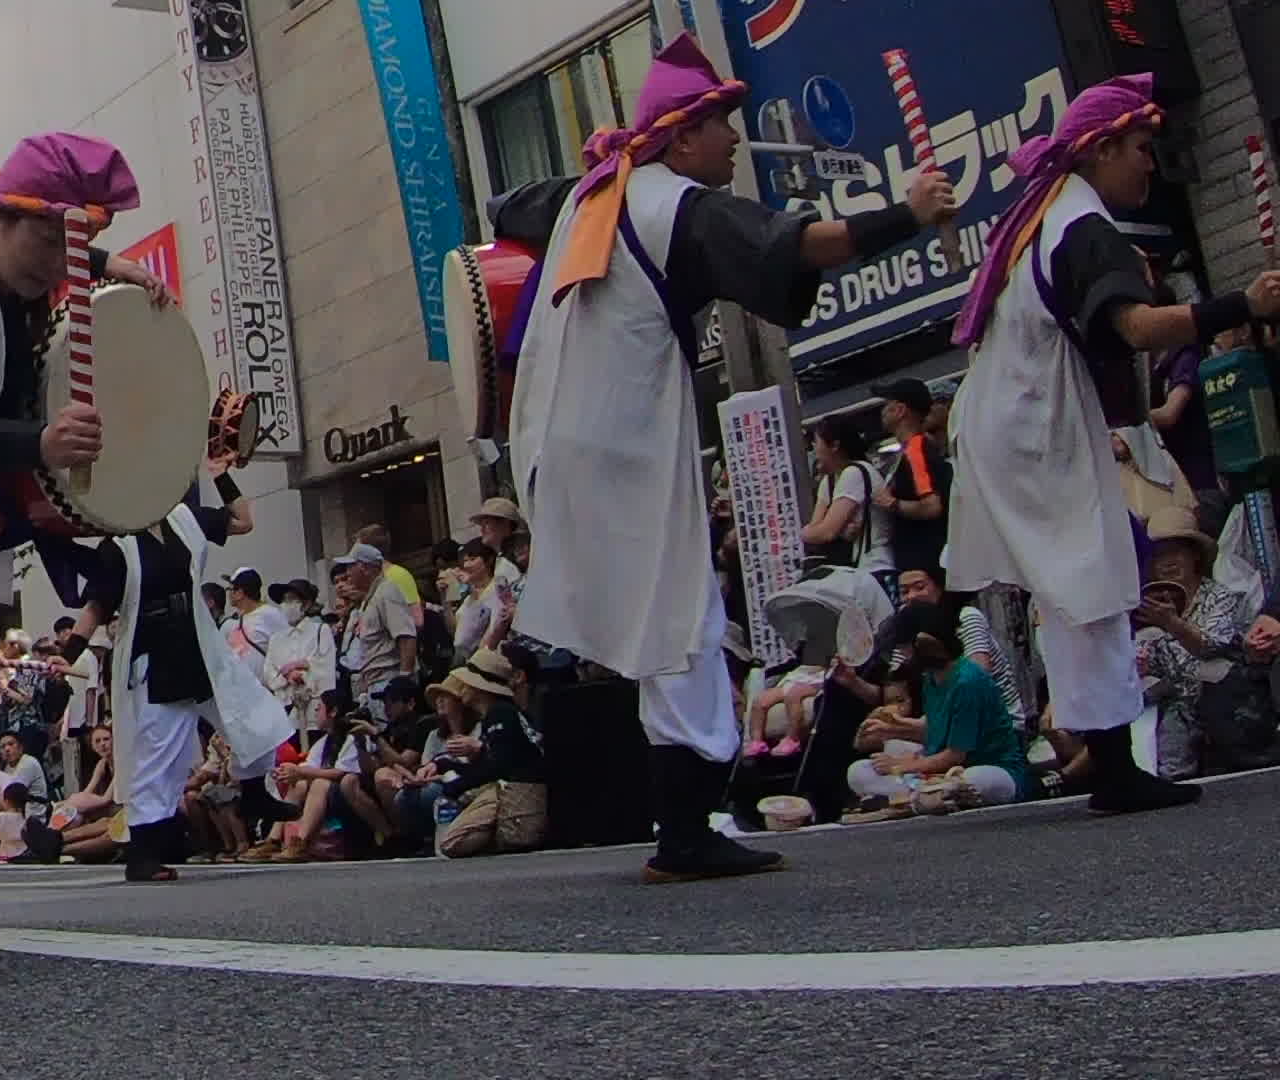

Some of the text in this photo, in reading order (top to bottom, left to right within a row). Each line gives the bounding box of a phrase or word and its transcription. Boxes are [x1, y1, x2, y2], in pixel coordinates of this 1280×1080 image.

[217, 108, 241, 179] PATEK
[255, 218, 287, 353] PANERAI
[841, 249, 924, 314] DRUG
[242, 300, 280, 448] ROLEX
[272, 358, 290, 441] OMEGA
[323, 404, 413, 465] Quark
